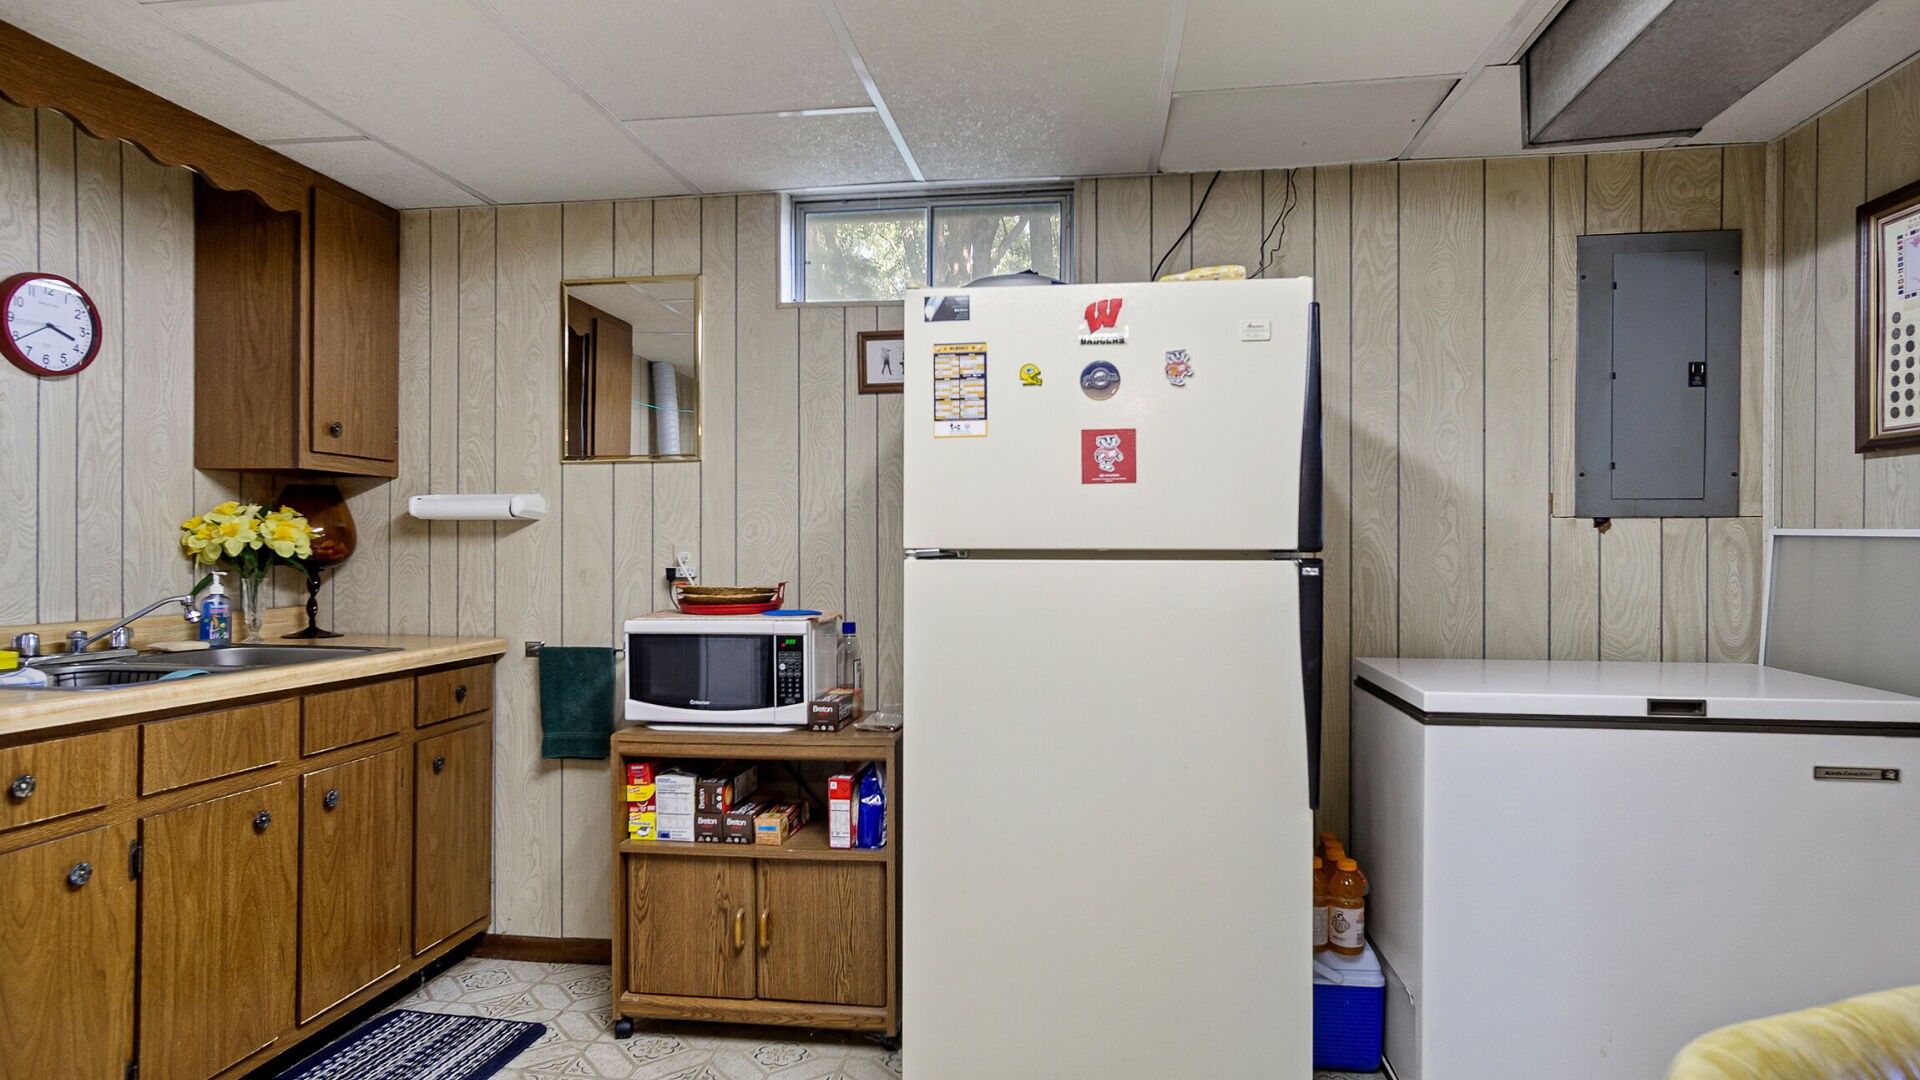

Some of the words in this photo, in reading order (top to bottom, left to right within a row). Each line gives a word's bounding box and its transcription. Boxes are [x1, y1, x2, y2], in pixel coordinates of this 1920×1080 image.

[28, 285, 36, 297] 11
[43, 287, 55, 297] 12
[13, 295, 24, 307] 10
[7, 311, 15, 322] 9
[74, 309, 81, 320] 2
[1084, 298, 1123, 334] W
[79, 326, 86, 338] 3
[26, 345, 33, 356] 7
[73, 344, 80, 352] 4
[42, 354, 50, 365] 6
[60, 353, 67, 364] 5
[812, 704, 833, 713] Breton
[697, 816, 718, 825] Breton
[726, 817, 747, 826] Breton
